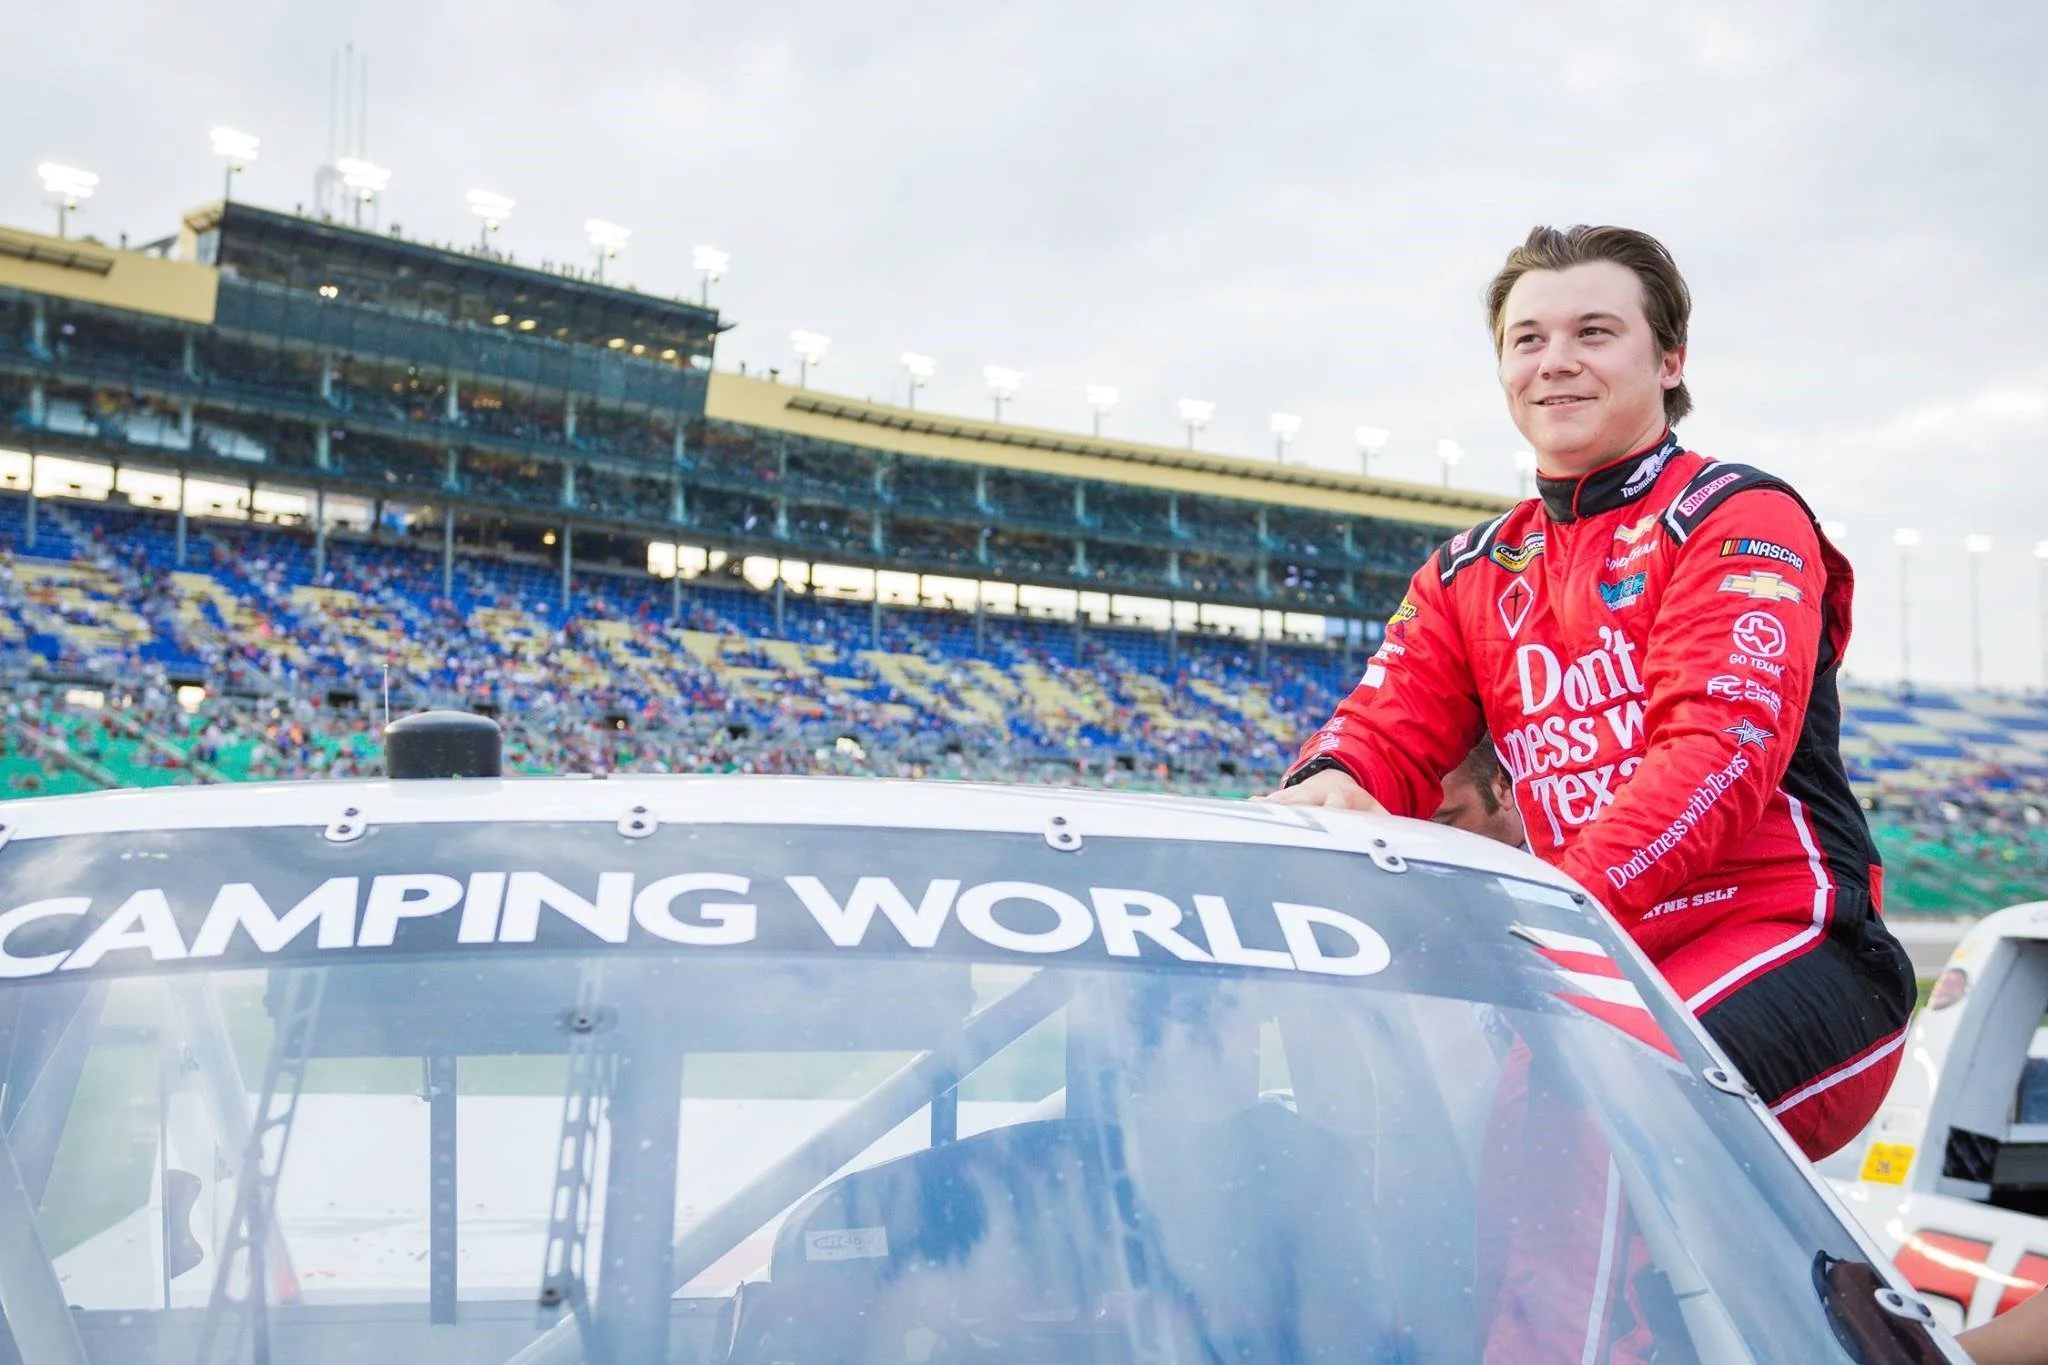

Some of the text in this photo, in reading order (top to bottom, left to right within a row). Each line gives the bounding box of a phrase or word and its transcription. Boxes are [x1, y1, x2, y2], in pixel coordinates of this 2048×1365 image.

[1682, 474, 1734, 513] SIMPSON
[1747, 540, 1804, 571] NASCAR
[1516, 626, 1645, 715] Don't
[1729, 653, 1748, 665] GO
[1504, 716, 1599, 783] mess
[1605, 849, 1655, 890] Don't
[1648, 820, 1689, 860] mess
[1681, 788, 1717, 827] with
[1692, 886, 1739, 906] SELF
[0, 872, 1390, 975] CAMPING WORLD
